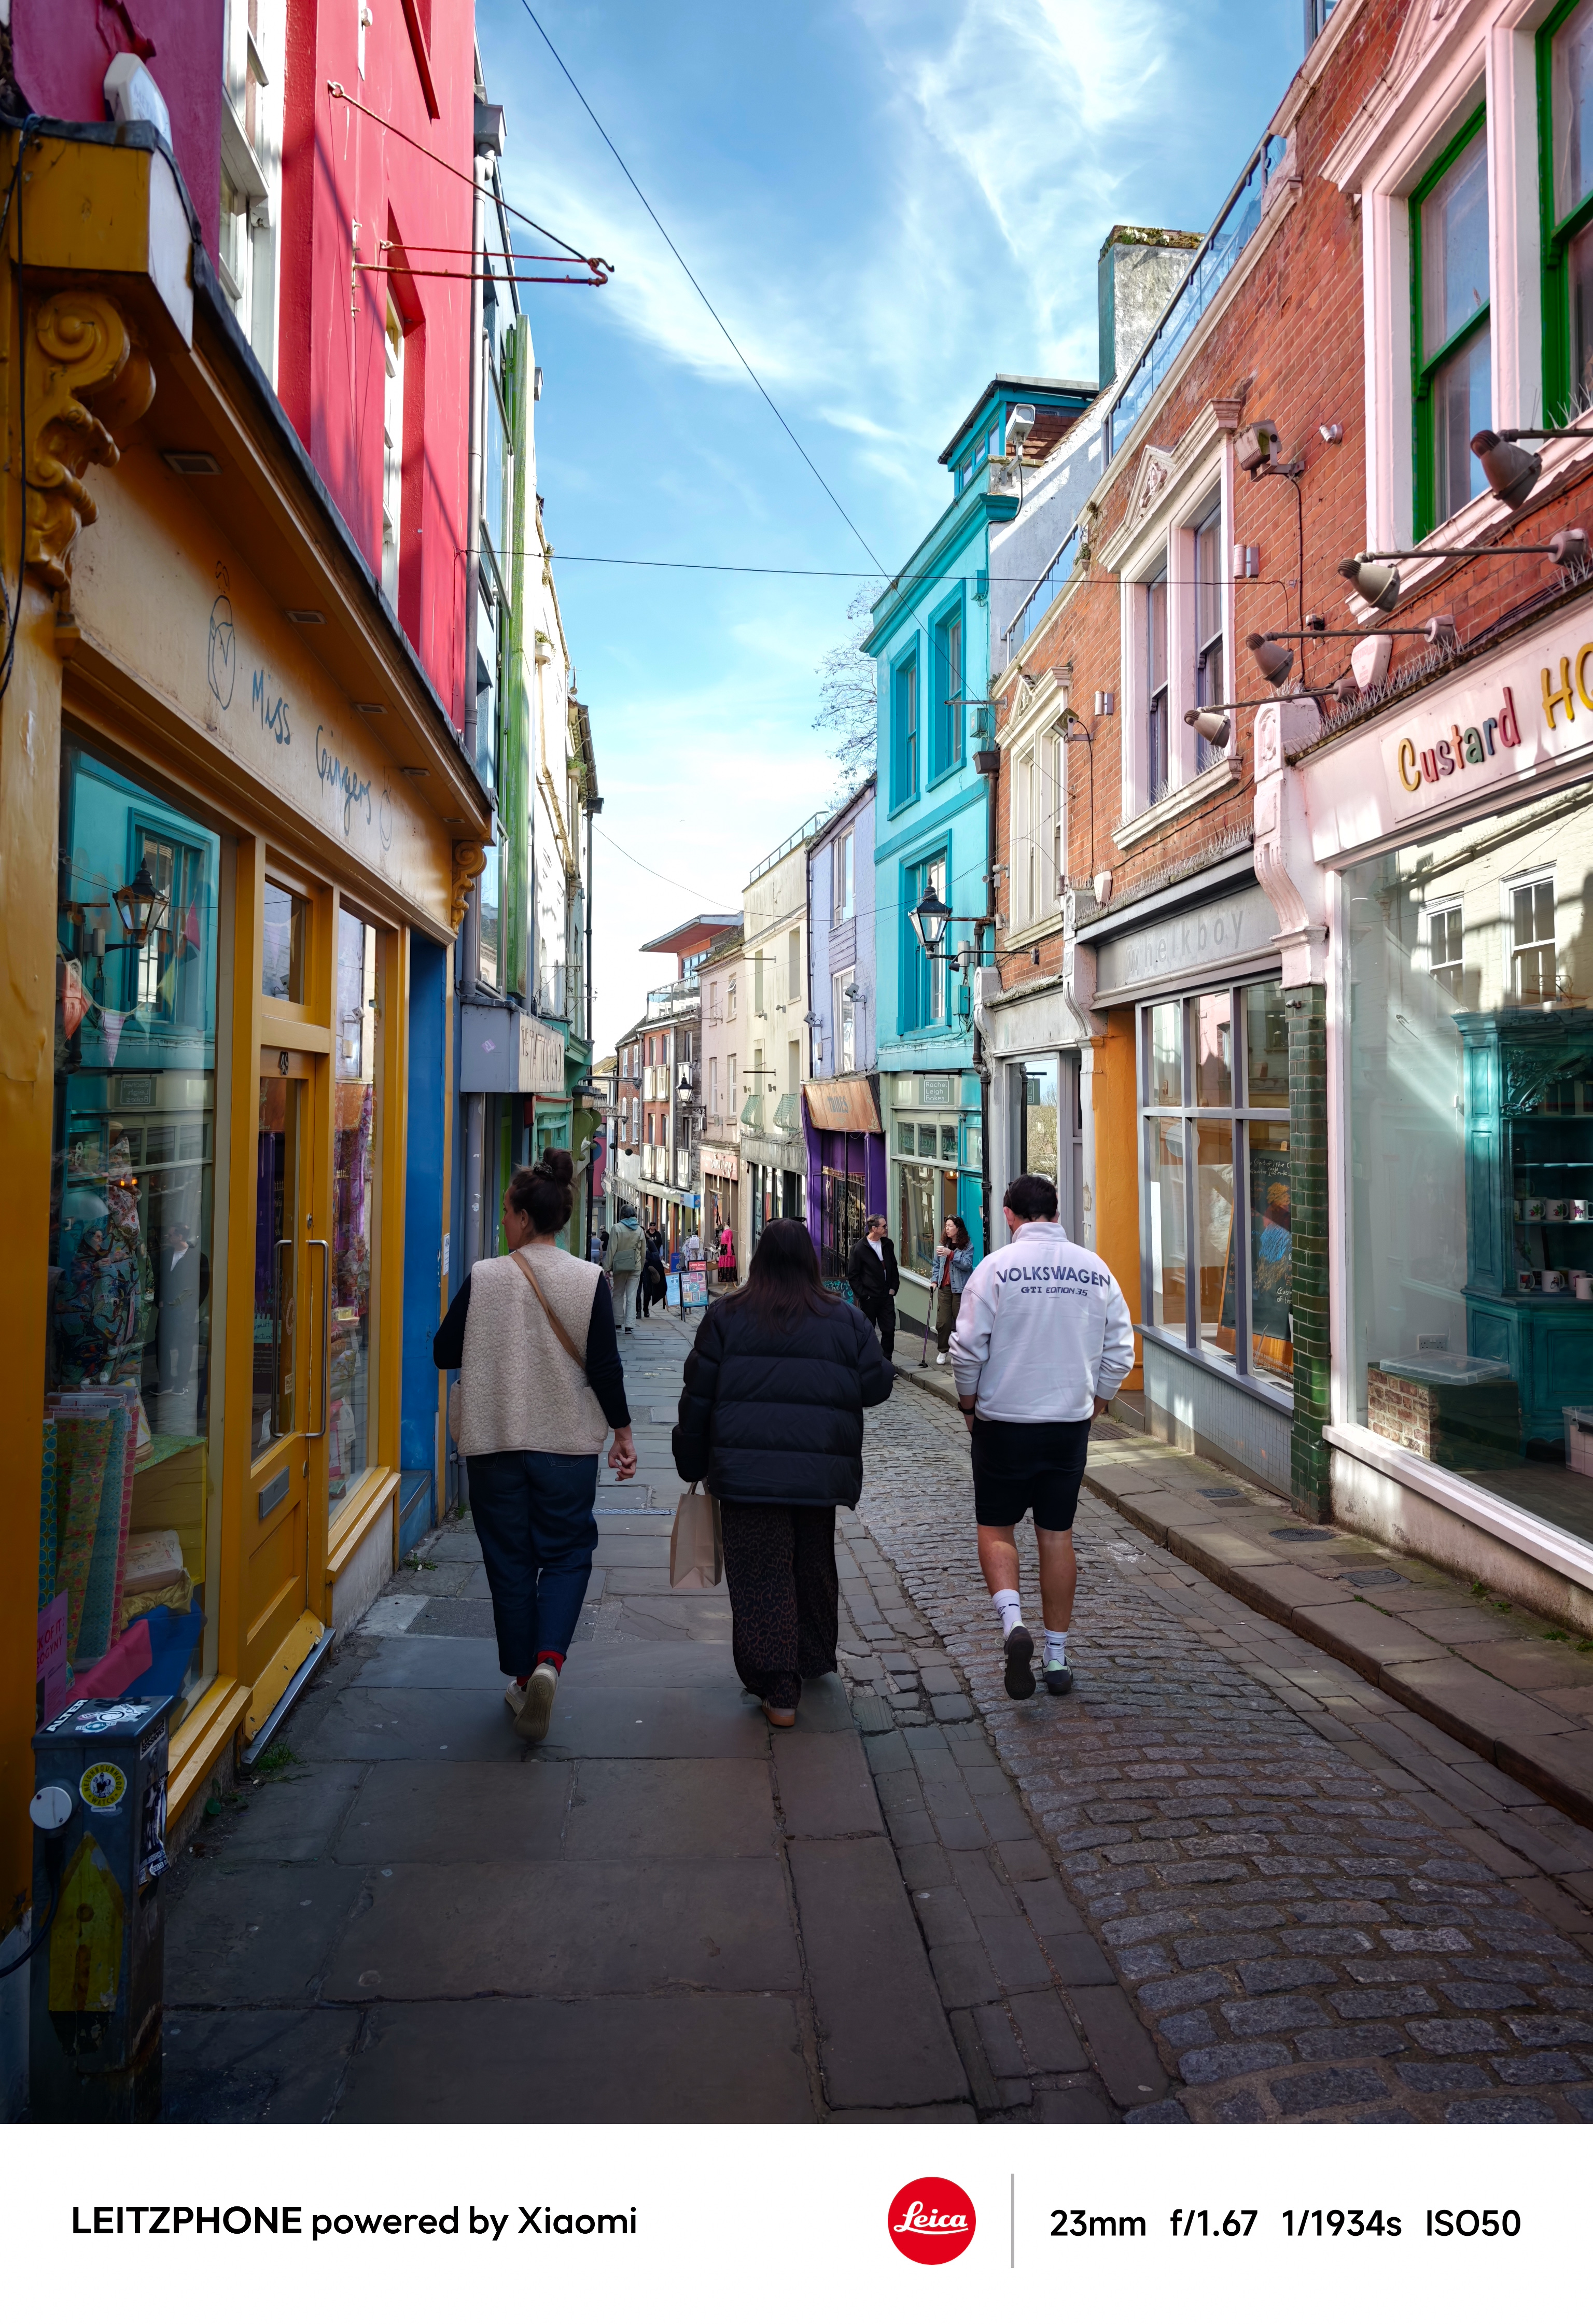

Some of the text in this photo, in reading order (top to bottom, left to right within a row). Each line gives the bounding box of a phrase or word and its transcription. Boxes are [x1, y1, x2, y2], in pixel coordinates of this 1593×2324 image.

[252, 668, 372, 836] Miss Gingers
[1398, 687, 1521, 792] Custard
[1126, 910, 1243, 973] whelkboy
[521, 1026, 529, 1057] THE
[529, 1030, 551, 1082] TATTOO
[827, 1096, 849, 1114] TRIBES
[996, 1266, 1111, 1287] VOLKSWAGEN
[1075, 1288, 1088, 1296] 35
[45, 1625, 54, 1644] OF
[46, 1699, 90, 1732] ALTER
[84, 1765, 122, 1792] NEIGHBOURHOOD
[91, 1796, 116, 1807] WATCH
